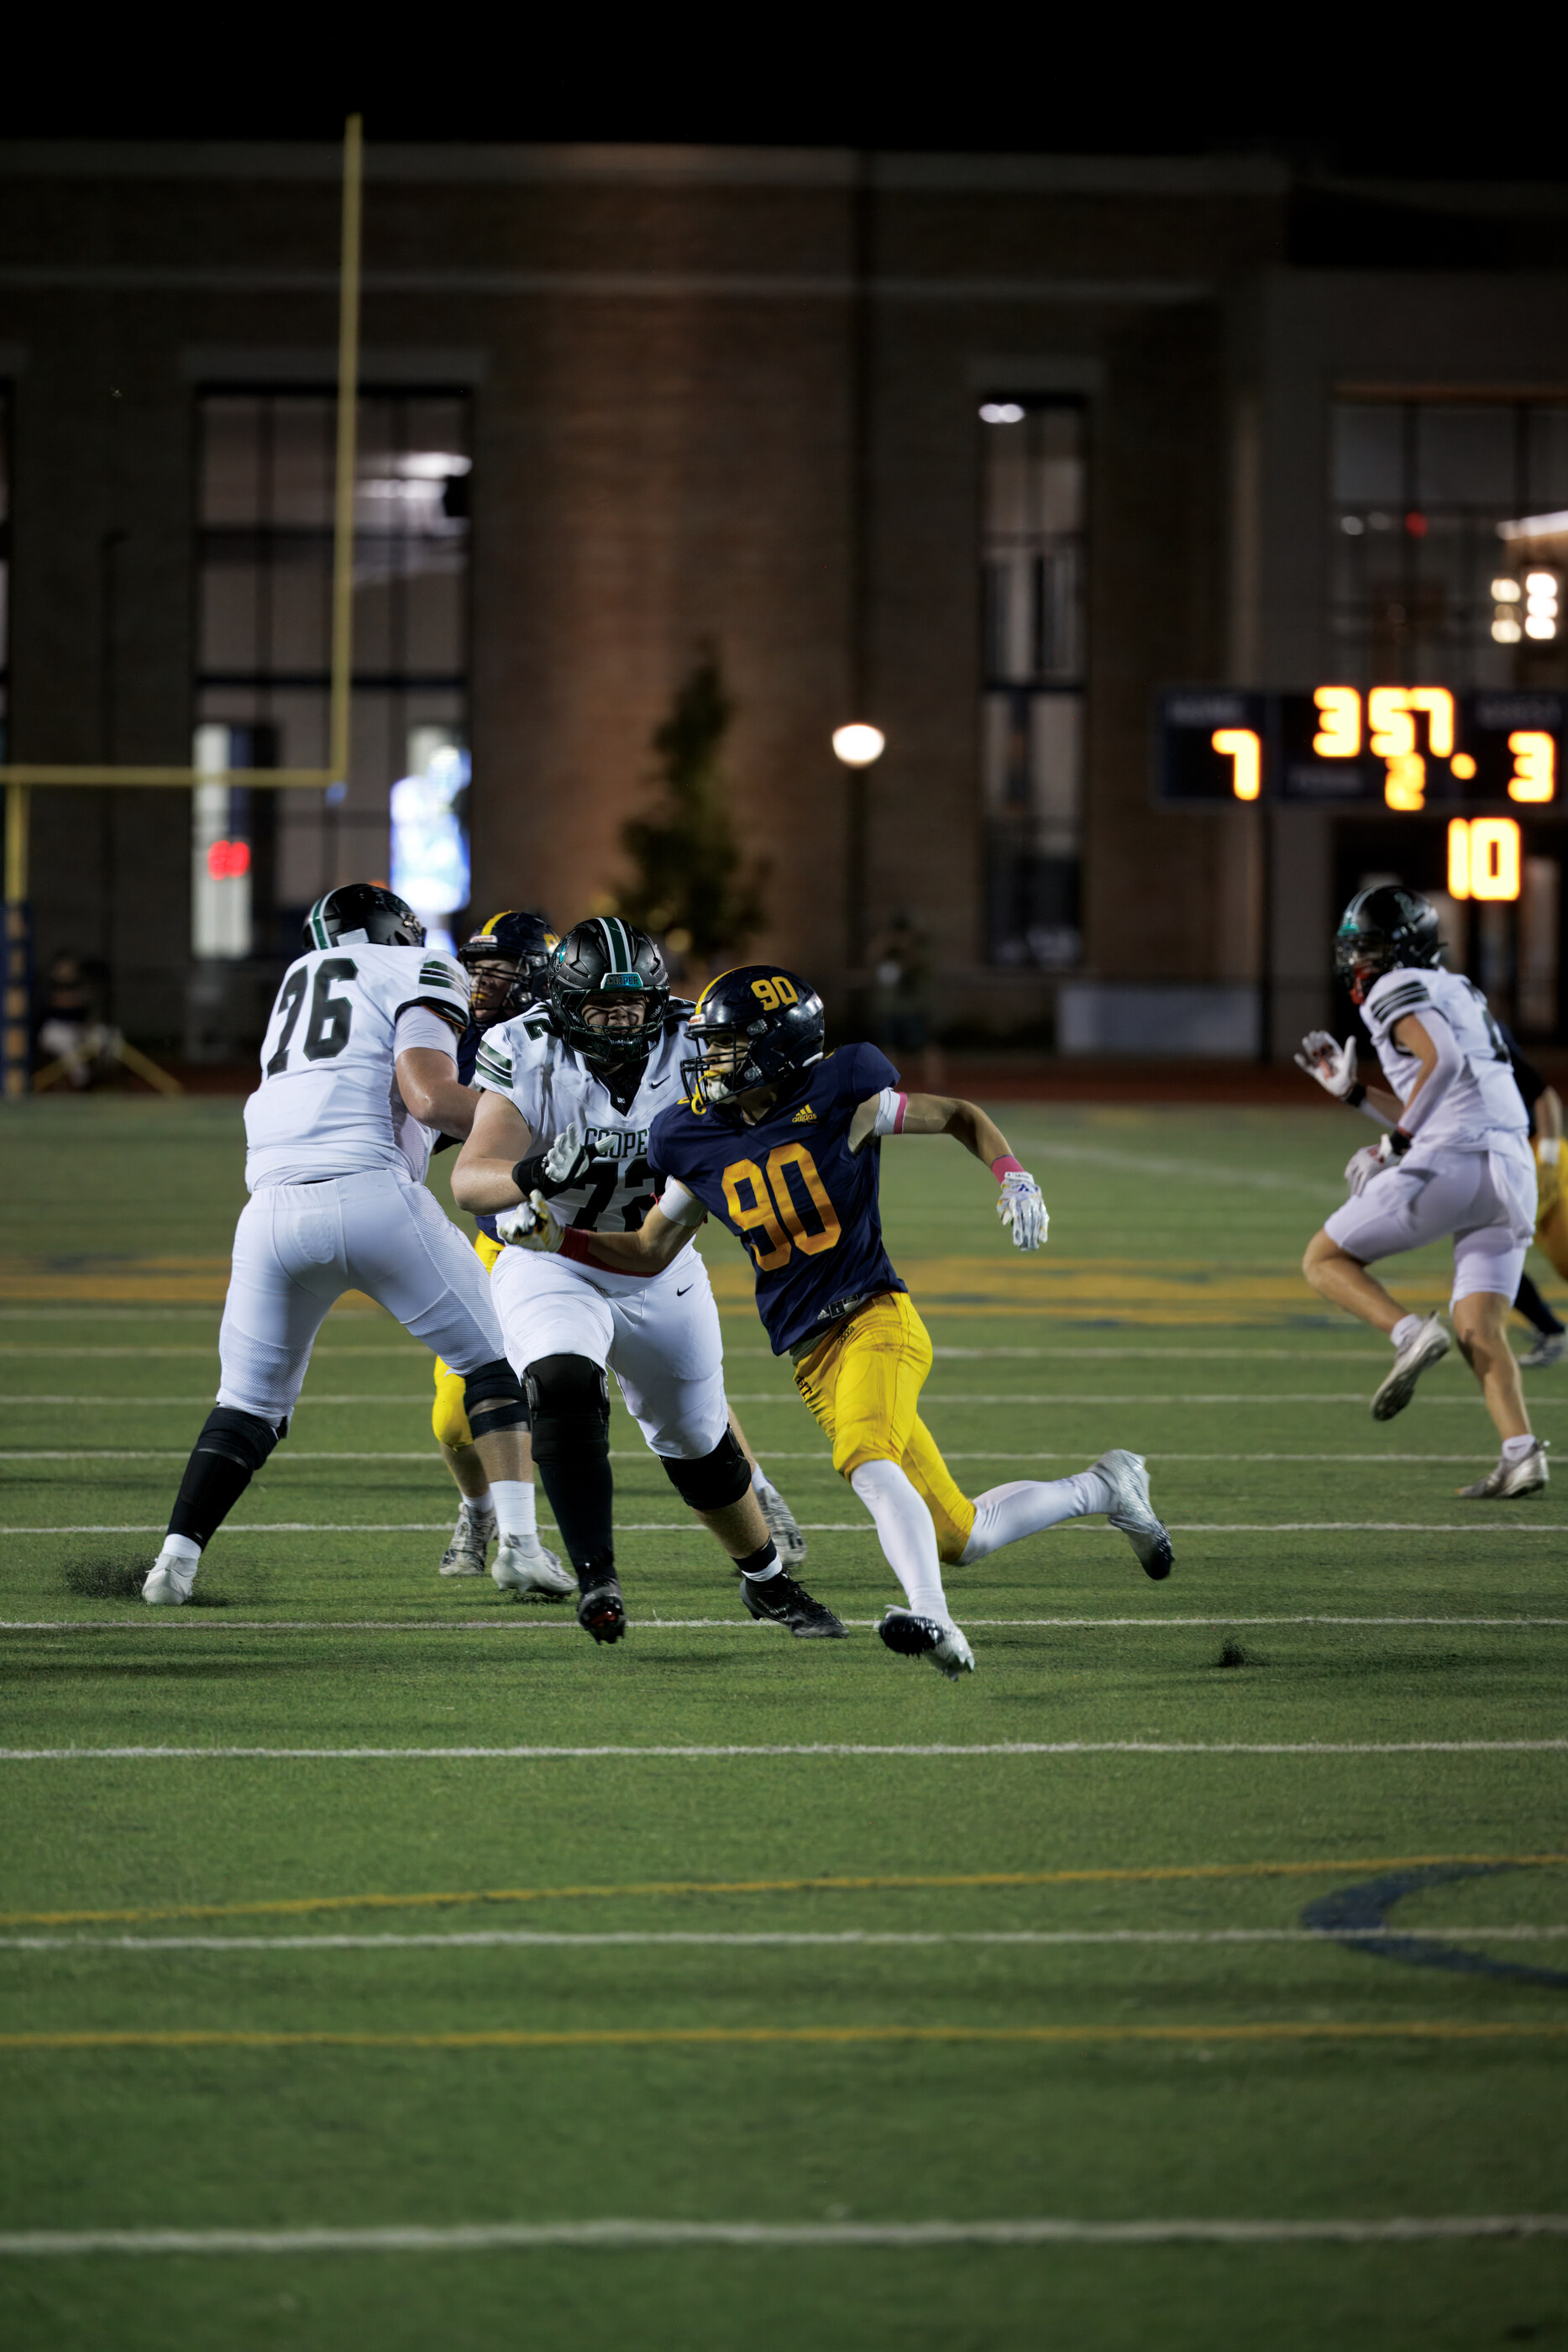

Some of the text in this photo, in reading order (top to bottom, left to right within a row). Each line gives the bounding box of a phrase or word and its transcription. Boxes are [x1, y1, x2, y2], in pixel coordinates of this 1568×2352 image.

[1211, 729, 1260, 801] 7
[1508, 732, 1554, 801] 3
[1449, 817, 1520, 900] 10
[606, 975, 638, 985] COOPER
[751, 976, 798, 1011] 90
[267, 958, 359, 1079] 76
[585, 1128, 650, 1158] COOPE
[792, 1112, 819, 1124] adidas
[567, 1158, 661, 1233] 72
[721, 1142, 842, 1272] 90
